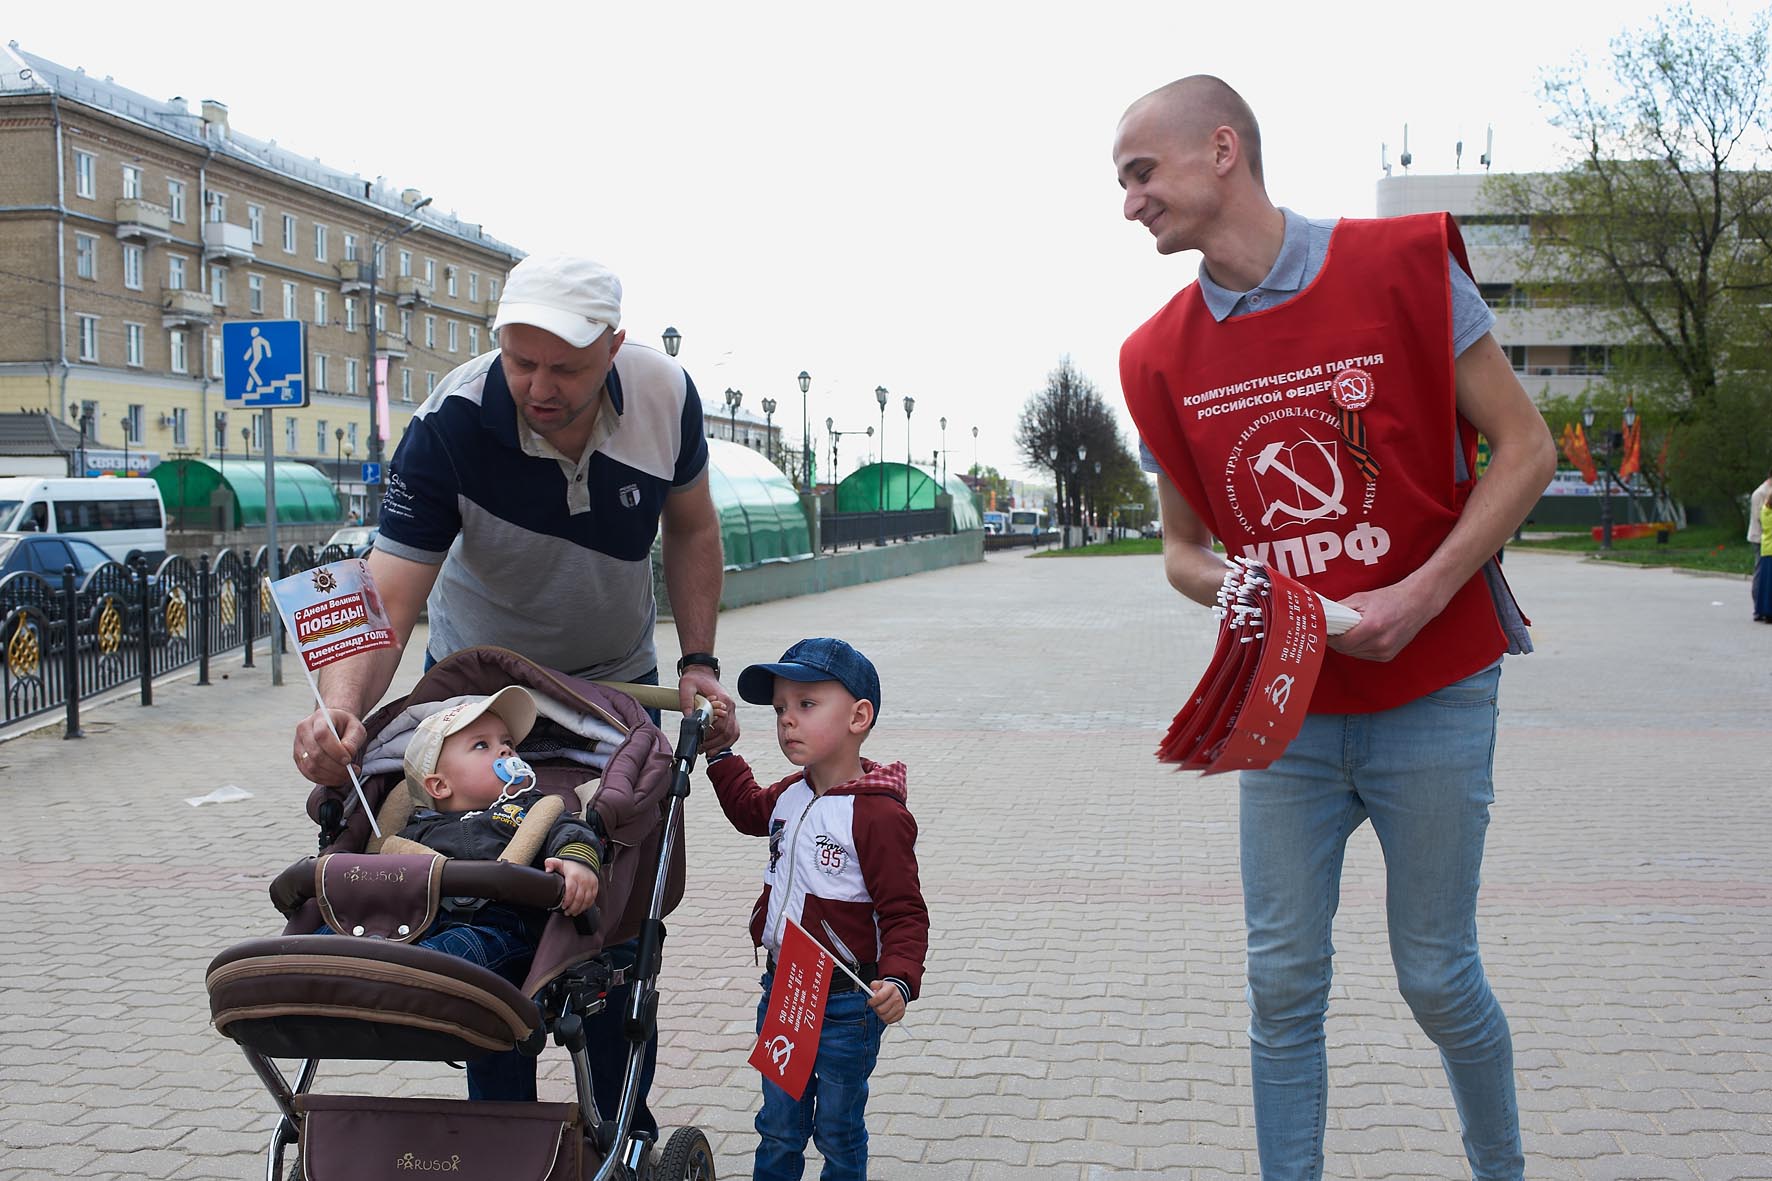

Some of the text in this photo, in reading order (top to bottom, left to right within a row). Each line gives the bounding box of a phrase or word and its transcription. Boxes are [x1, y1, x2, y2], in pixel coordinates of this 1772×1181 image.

[1183, 364, 1323, 406] КОММУНИСТИЧЕСКАЯ
[1326, 353, 1384, 374] ПАРТИЯ
[1197, 390, 1283, 420] РОССИЙСКОЙ
[1286, 380, 1333, 399] ФЕДЕР
[1225, 406, 1342, 534] РОССИЯ ТРУД НАРОДОВЛАСТИЕ
[1242, 521, 1391, 579] КПРФ
[295, 593, 361, 620] С Днем Великой
[300, 604, 365, 637] ПОБЕДЫ!
[308, 637, 364, 661] Александр
[820, 849, 842, 868] 95
[803, 1008, 816, 1029] 79
